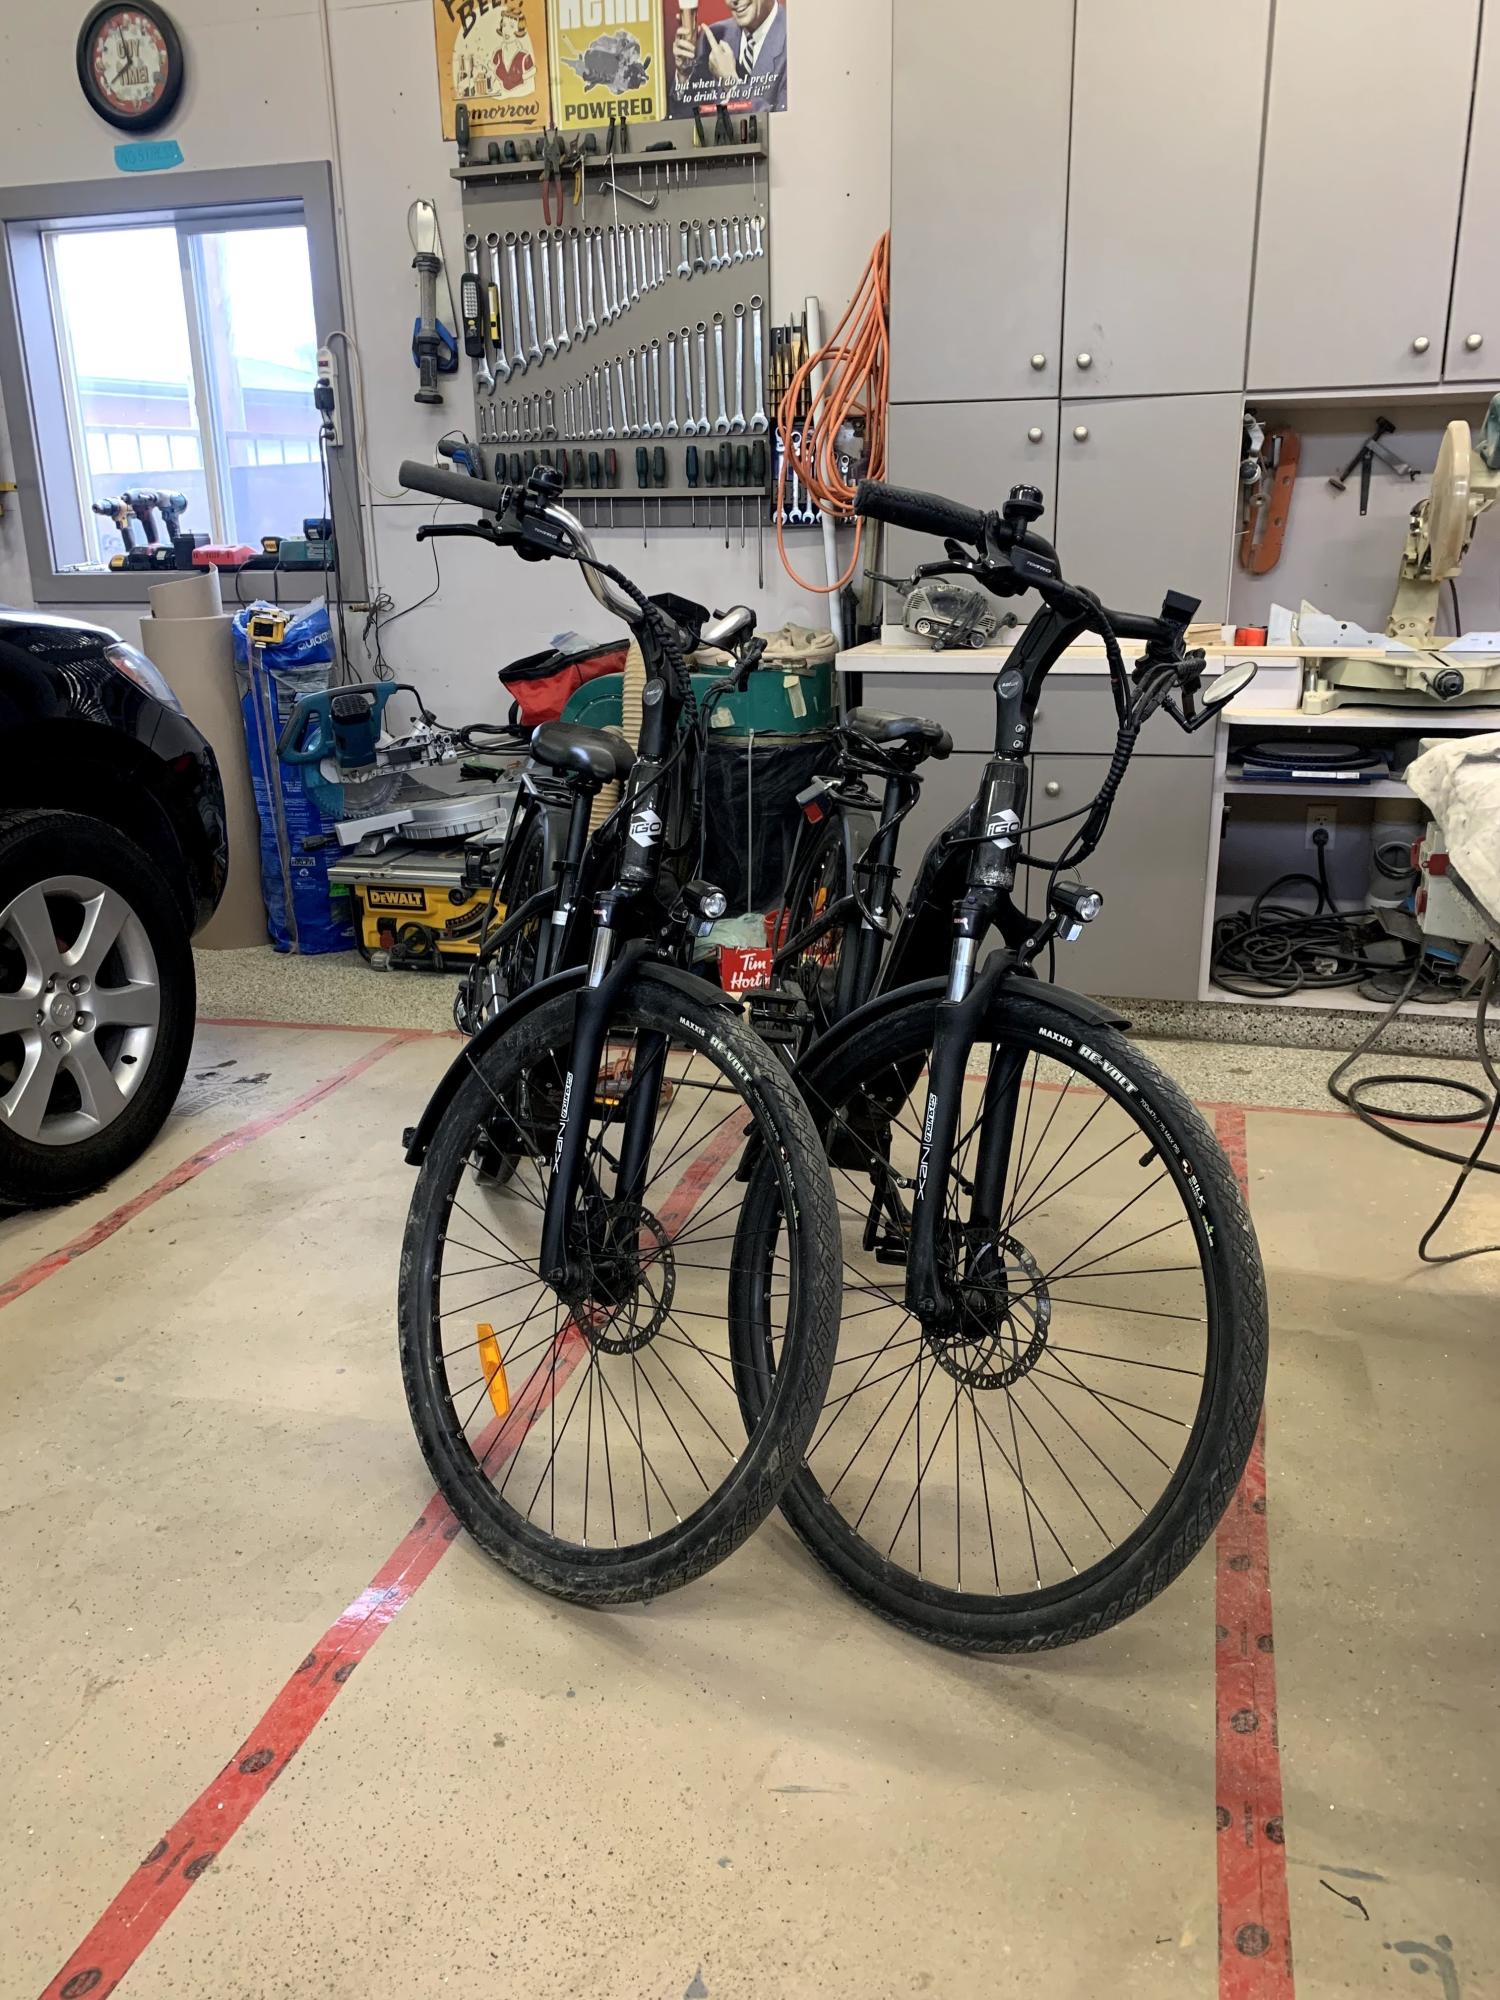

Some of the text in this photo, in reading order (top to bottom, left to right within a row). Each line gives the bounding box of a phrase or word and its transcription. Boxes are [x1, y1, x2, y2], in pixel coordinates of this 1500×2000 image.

[675, 81, 690, 91] but
[692, 78, 715, 89] when
[718, 77, 722, 87] I
[750, 72, 779, 87] prefer
[683, 94, 691, 103] to
[694, 90, 718, 102] drink
[720, 91, 726, 99] a
[742, 86, 753, 99] of
[565, 97, 652, 121] POWERED
[740, 953, 766, 971] Tim
[679, 1016, 706, 1037] MAXXIS
[1039, 1027, 1139, 1095] MAXXIS RE-VOLT
[1163, 1130, 1175, 1145] MAX
[1190, 1175, 1206, 1205] SILK
